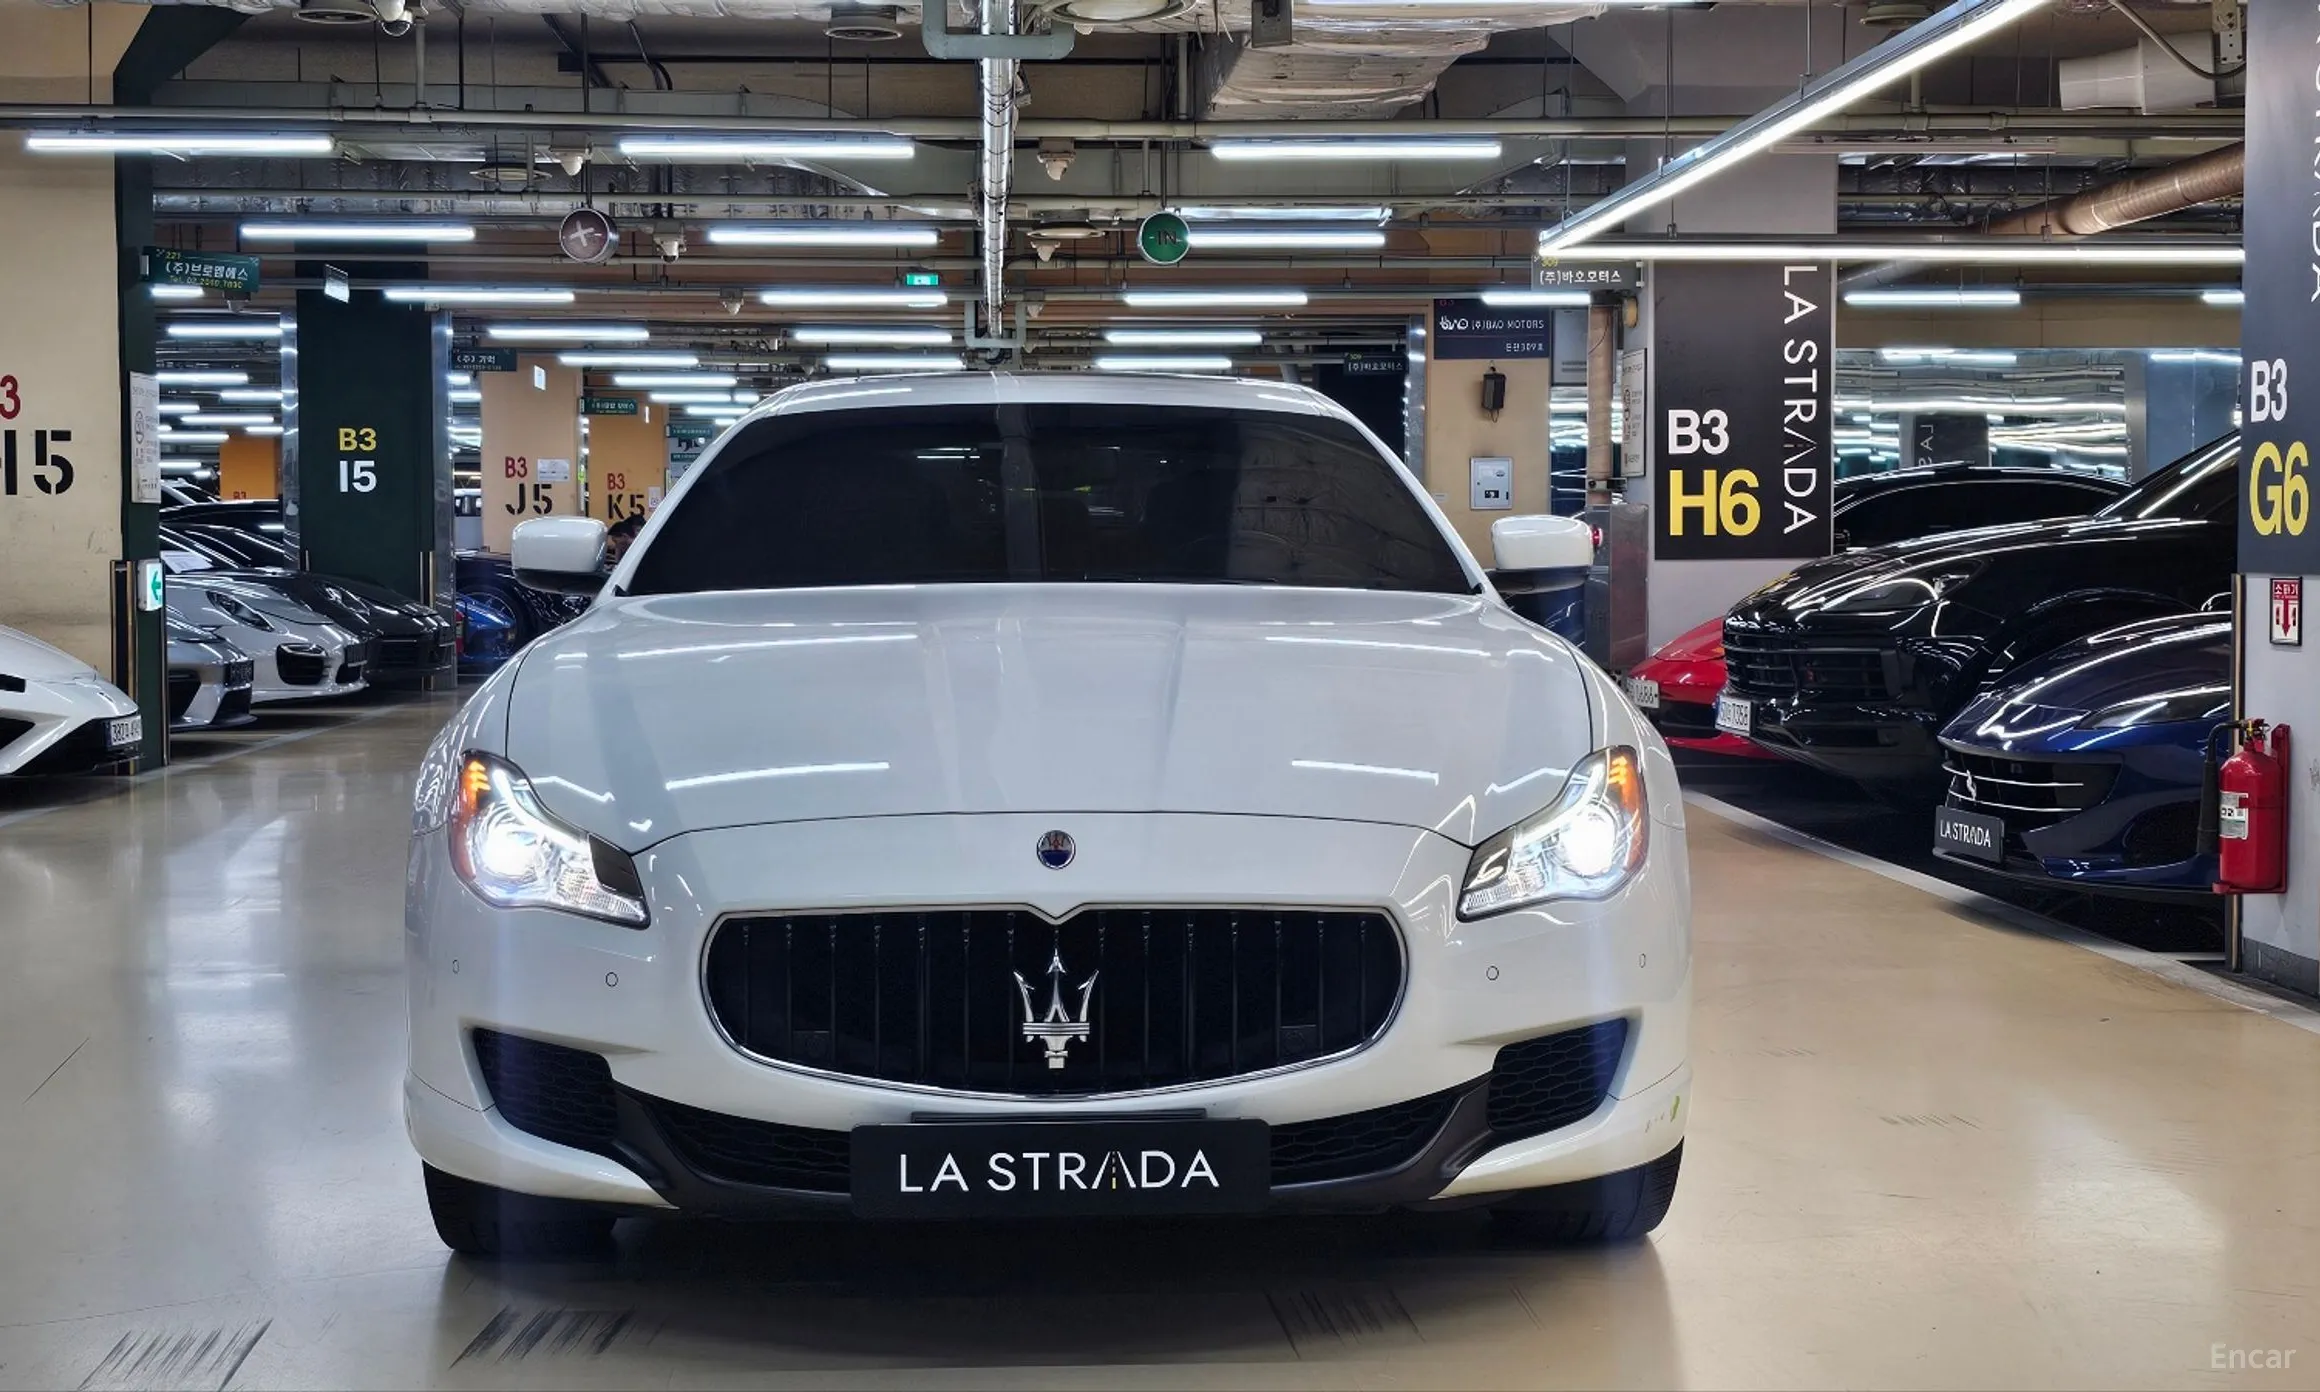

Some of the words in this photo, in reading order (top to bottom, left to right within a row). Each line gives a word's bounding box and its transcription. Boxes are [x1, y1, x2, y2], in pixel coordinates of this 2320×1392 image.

[1540, 270, 1622, 285] (주)바오모터스
[1784, 265, 1818, 324] LA
[1508, 319, 1545, 329] MOTORS
[2250, 358, 2288, 423] B3
[339, 427, 377, 451] B3
[1667, 409, 1730, 456] B3
[1784, 338, 1818, 534] STRADA
[505, 456, 528, 478] B3
[607, 473, 625, 490] B3
[505, 483, 553, 515] J5
[1669, 468, 1761, 537] H6
[2250, 441, 2309, 536] G6
[607, 494, 645, 519] K5
[1940, 819, 1952, 839] LA
[1952, 822, 1991, 848] STRADA
[900, 1152, 969, 1192] LA
[987, 1148, 1220, 1192] STRADA
